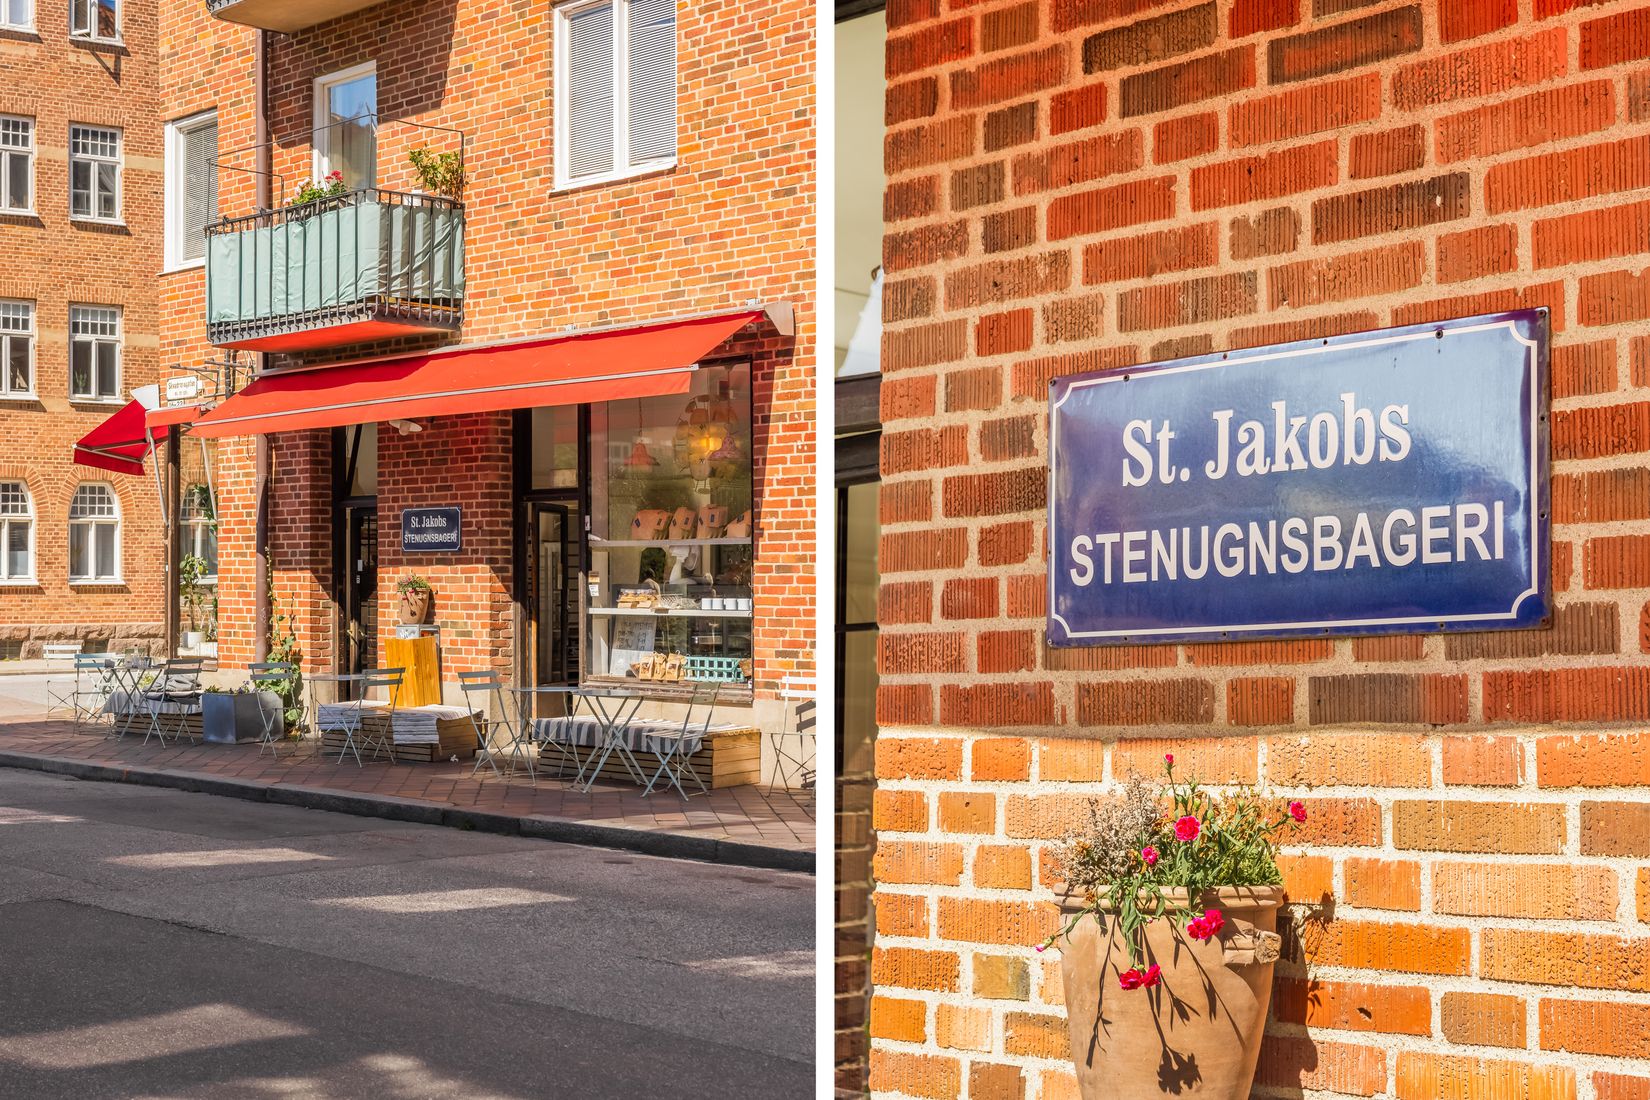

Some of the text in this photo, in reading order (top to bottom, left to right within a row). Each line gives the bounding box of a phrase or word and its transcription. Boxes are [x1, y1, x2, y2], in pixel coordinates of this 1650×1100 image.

[1121, 392, 1412, 487] St. Jakobs
[404, 533, 457, 543] STENUGNSBAGERI
[411, 515, 447, 528] St. Jakobs
[1069, 501, 1505, 587] STENUGNSBAGERI
